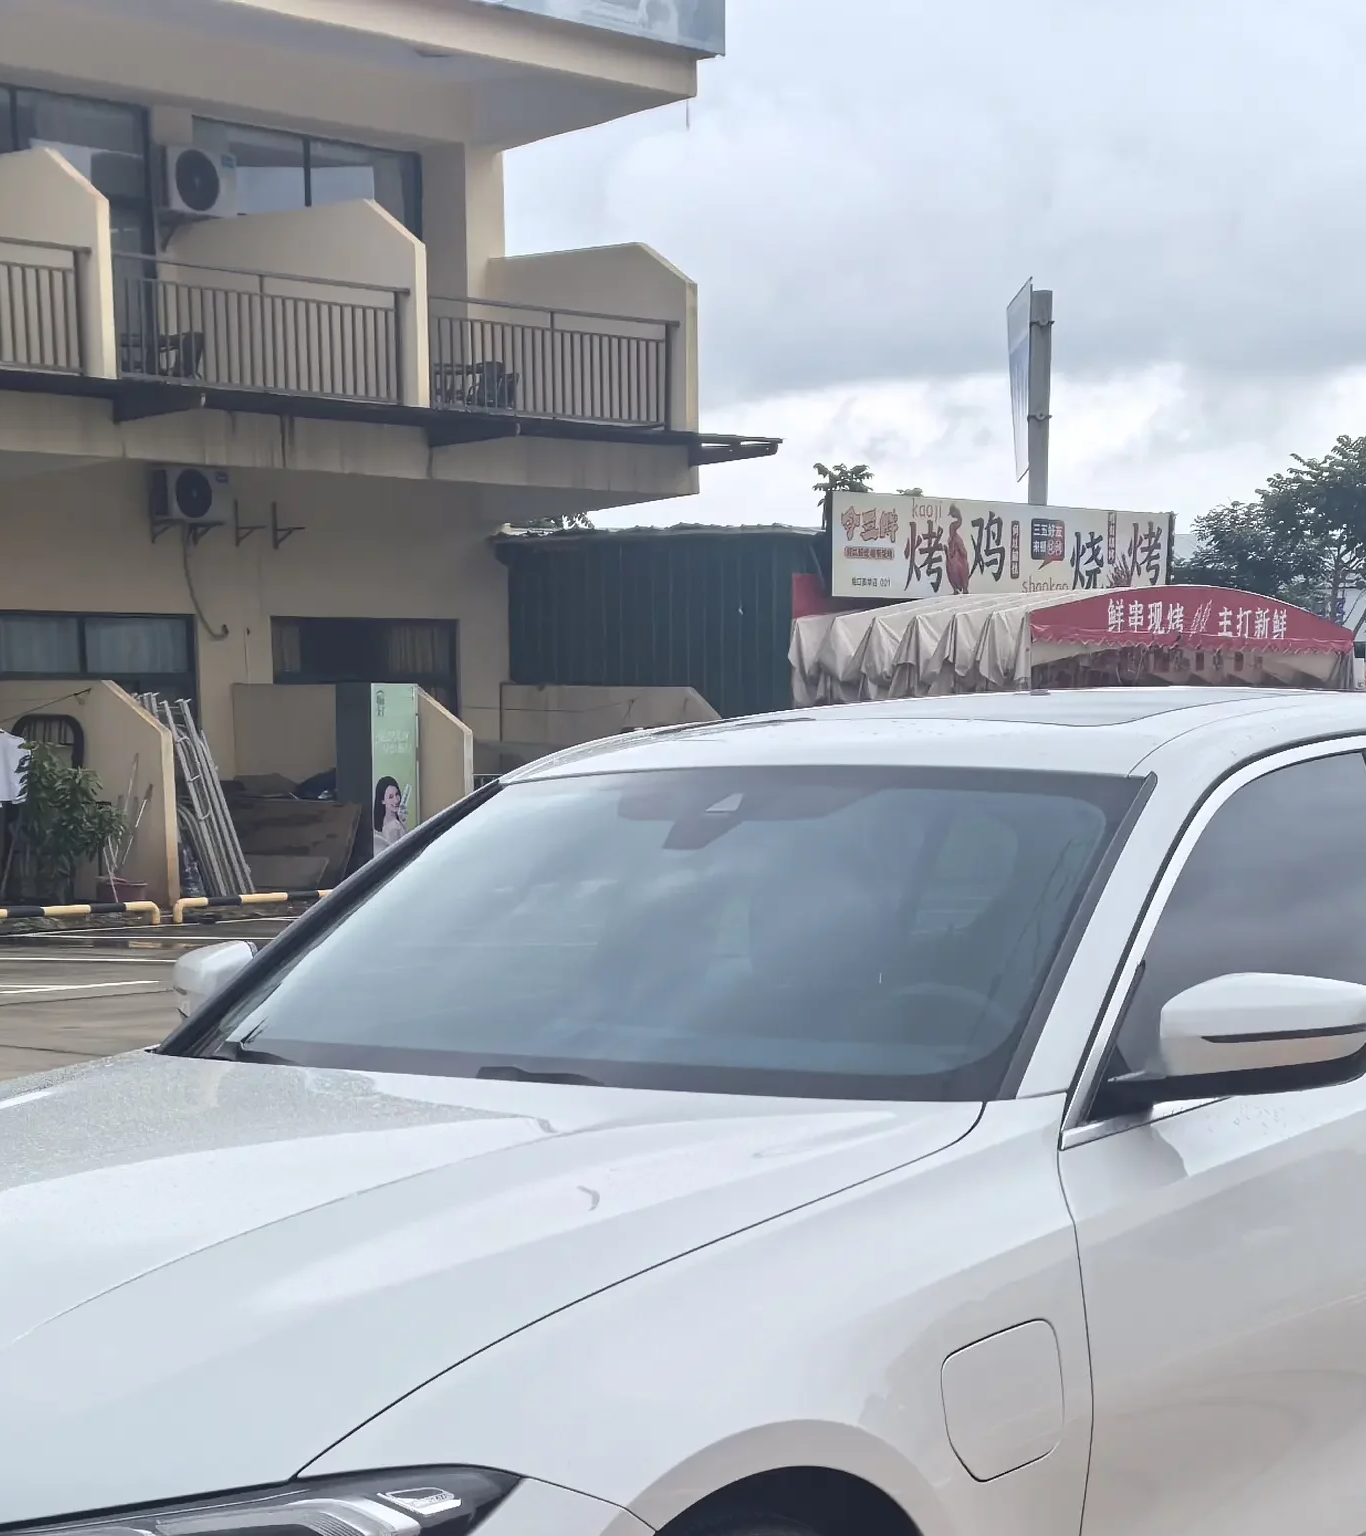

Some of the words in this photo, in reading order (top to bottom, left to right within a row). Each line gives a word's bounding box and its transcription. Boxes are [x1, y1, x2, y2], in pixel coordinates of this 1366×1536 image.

[911, 499, 942, 522] kaoji
[1107, 598, 1185, 634] 鲜串现烤
[1218, 606, 1287, 640] 主打新鲜
